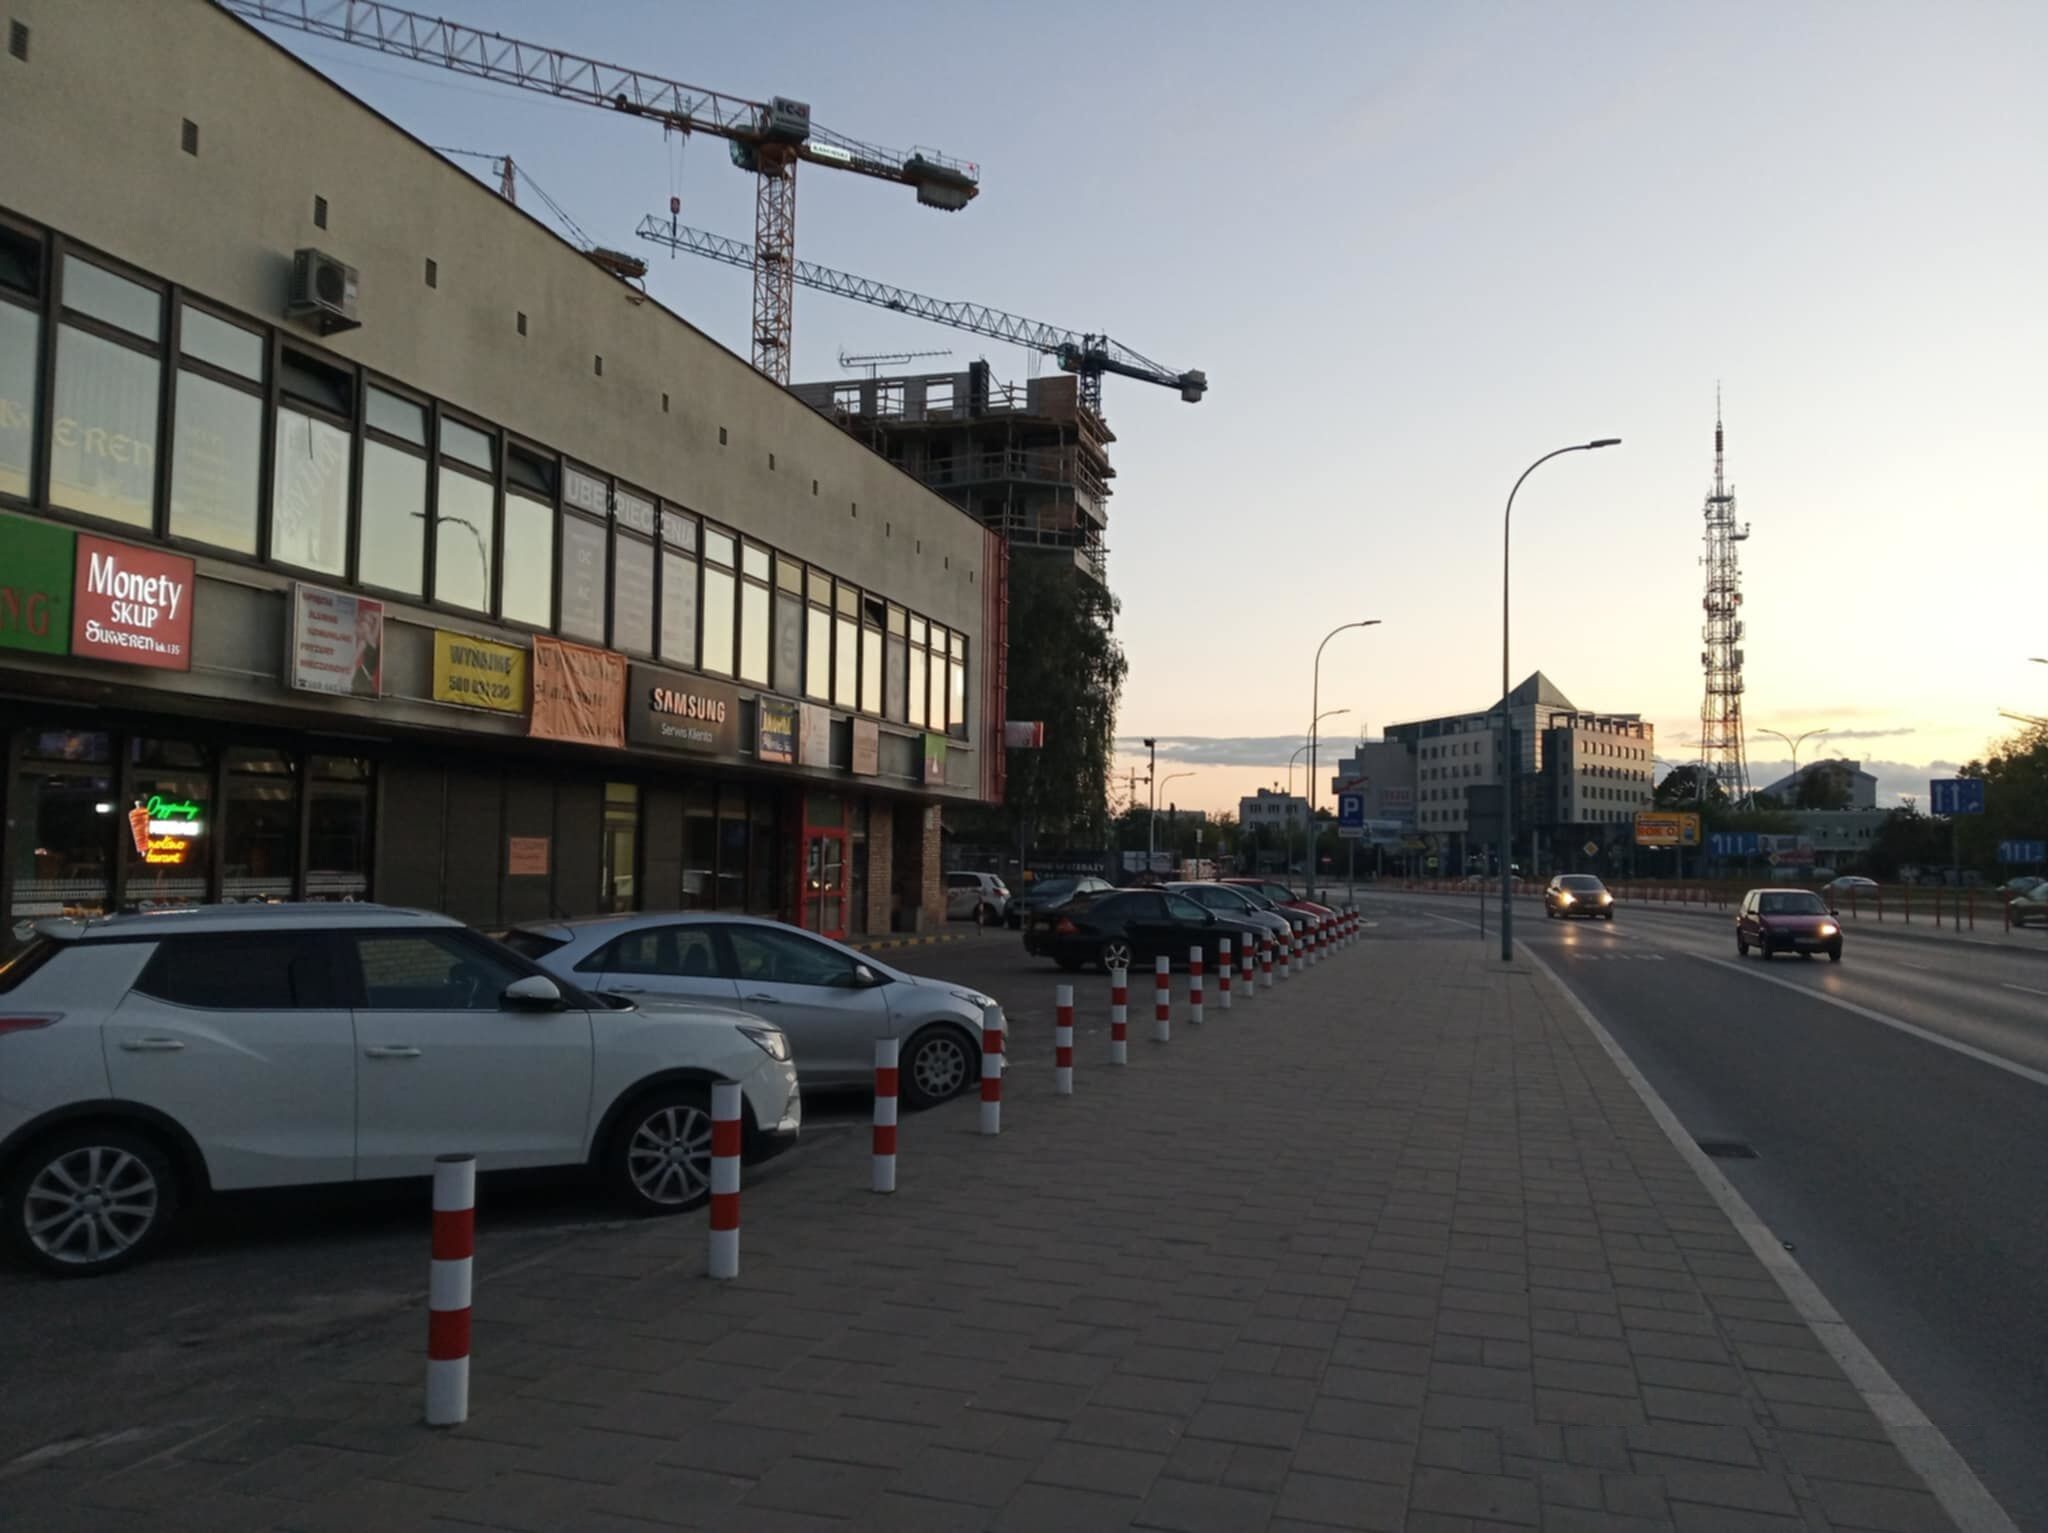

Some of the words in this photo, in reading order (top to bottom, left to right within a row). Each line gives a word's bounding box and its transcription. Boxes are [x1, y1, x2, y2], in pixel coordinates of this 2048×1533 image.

[88, 552, 182, 620] Monety
[111, 601, 159, 629] SKUP
[654, 688, 725, 722] SAMSUNG
[1343, 797, 1359, 817] P
